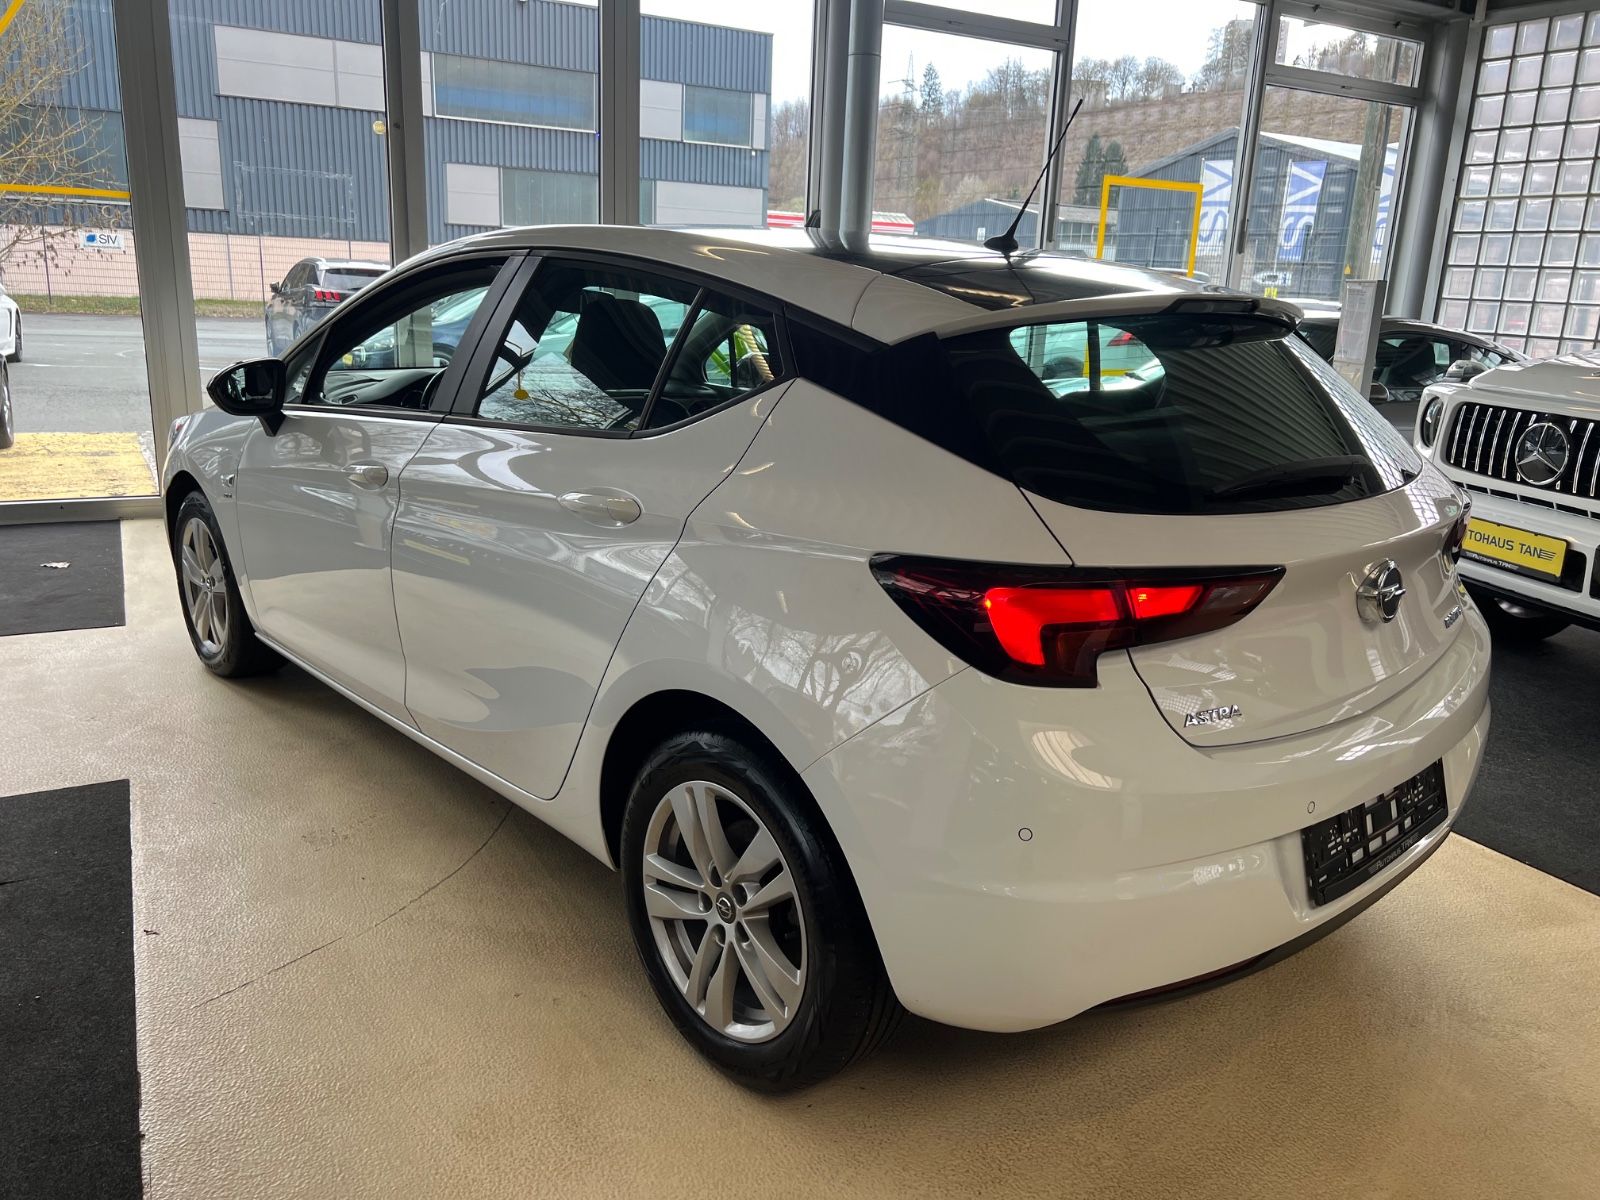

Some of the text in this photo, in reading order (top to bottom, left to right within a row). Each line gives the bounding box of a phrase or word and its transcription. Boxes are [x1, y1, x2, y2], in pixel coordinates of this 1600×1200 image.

[1199, 163, 1233, 243] SIV
[1281, 165, 1323, 249] SIV
[98, 233, 118, 245] SIV
[1518, 542, 1542, 559] TAN
[1183, 704, 1242, 728] ASTRA
